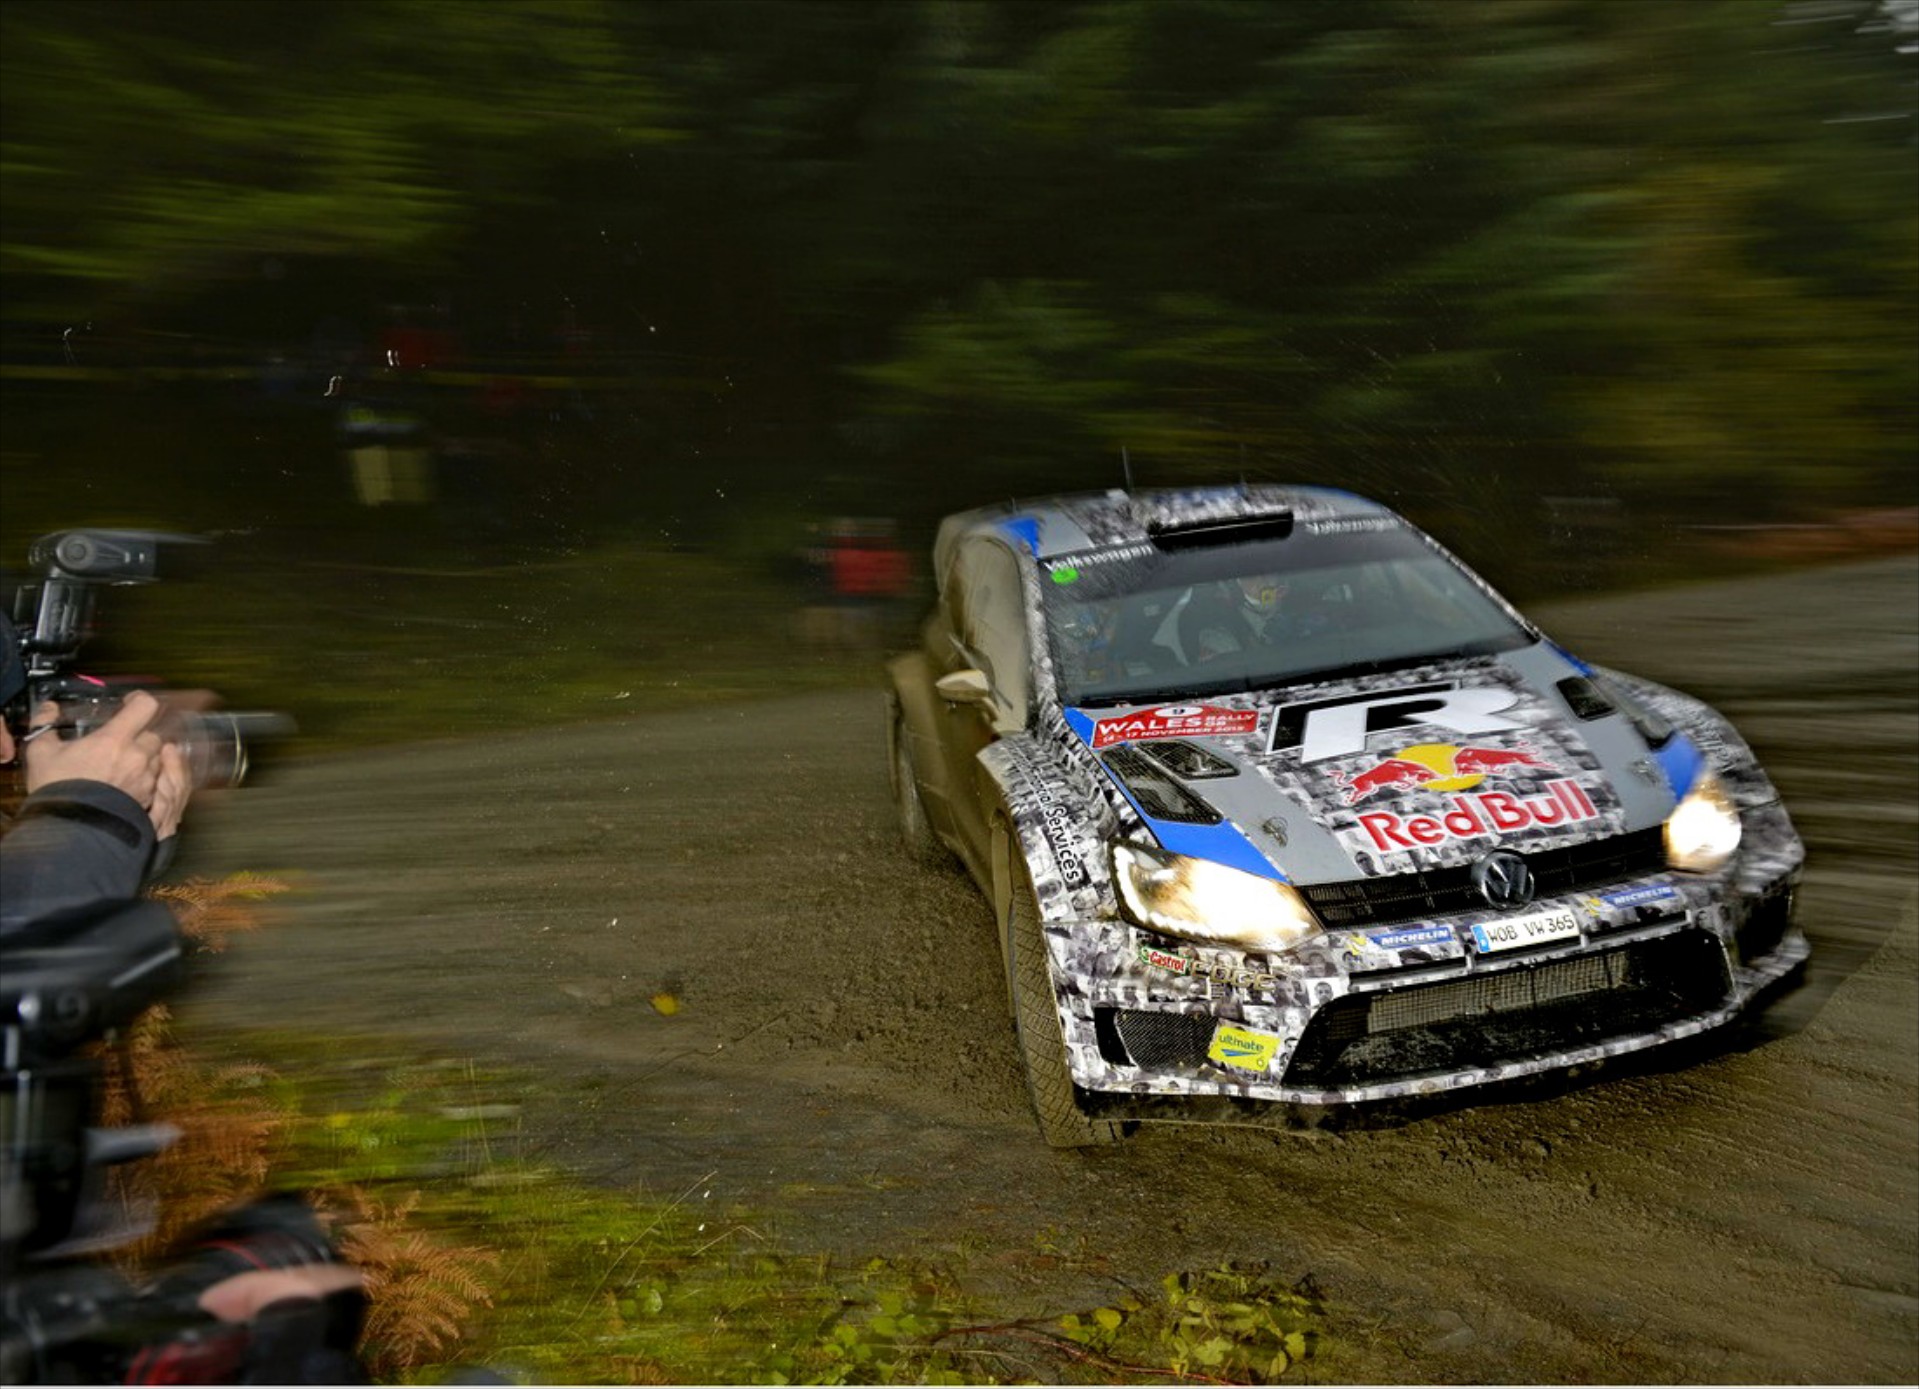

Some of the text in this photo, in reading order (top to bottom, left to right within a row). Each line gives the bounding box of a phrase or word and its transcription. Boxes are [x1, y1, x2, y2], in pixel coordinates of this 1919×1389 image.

[1099, 717, 1202, 735] WALES
[1205, 714, 1255, 722] RALLY
[1141, 727, 1211, 737] NOVEMBER
[1358, 779, 1598, 851] Red Bull
[1047, 805, 1081, 881] Services
[1381, 929, 1448, 946] MICHELIN
[1486, 914, 1575, 943] WOB VW 365
[1150, 950, 1187, 974] Castrol
[1218, 1034, 1265, 1052] ultimate
